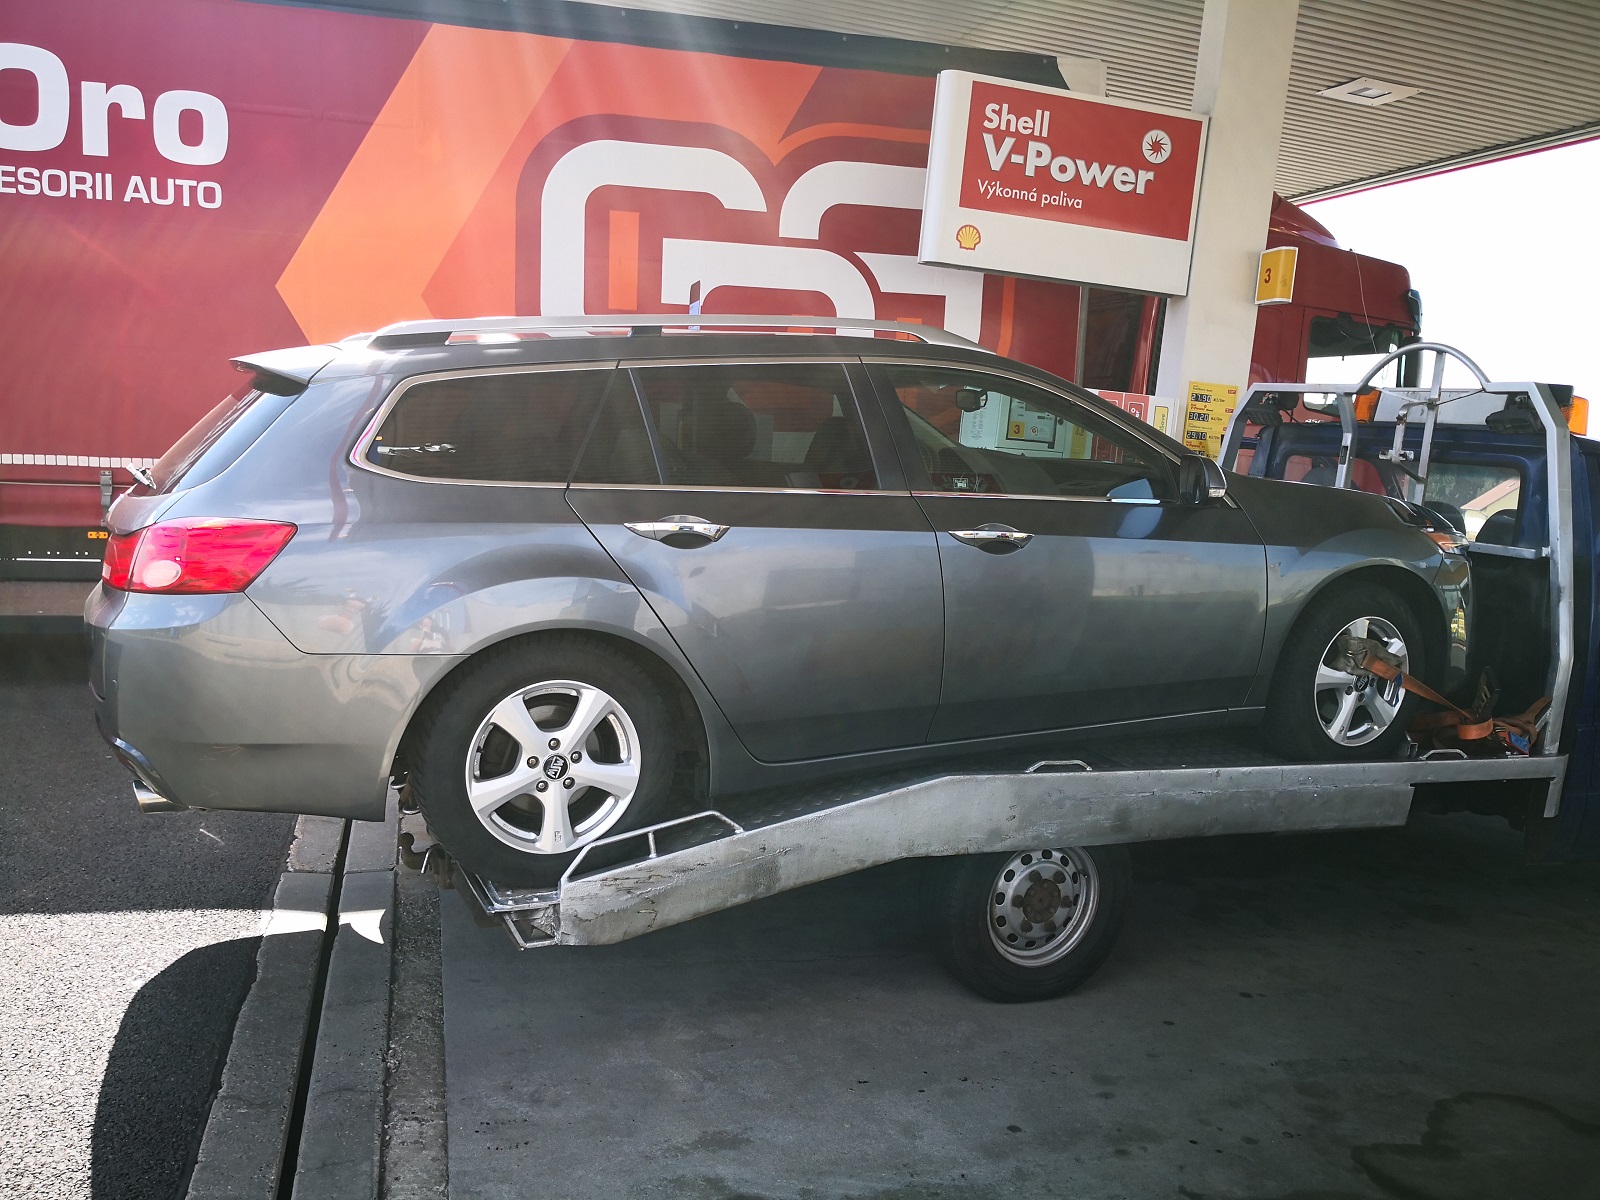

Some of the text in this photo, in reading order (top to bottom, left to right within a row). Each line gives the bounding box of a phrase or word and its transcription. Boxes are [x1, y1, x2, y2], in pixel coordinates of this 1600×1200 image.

[0, 42, 229, 166] Oro
[982, 102, 1050, 137] Shell
[981, 132, 1156, 195] V-Power
[0, 164, 222, 209] ESORII AUTO
[977, 178, 1083, 209] Výkonná paliva
[1263, 267, 1272, 284] 3
[1013, 424, 1021, 434] 3
